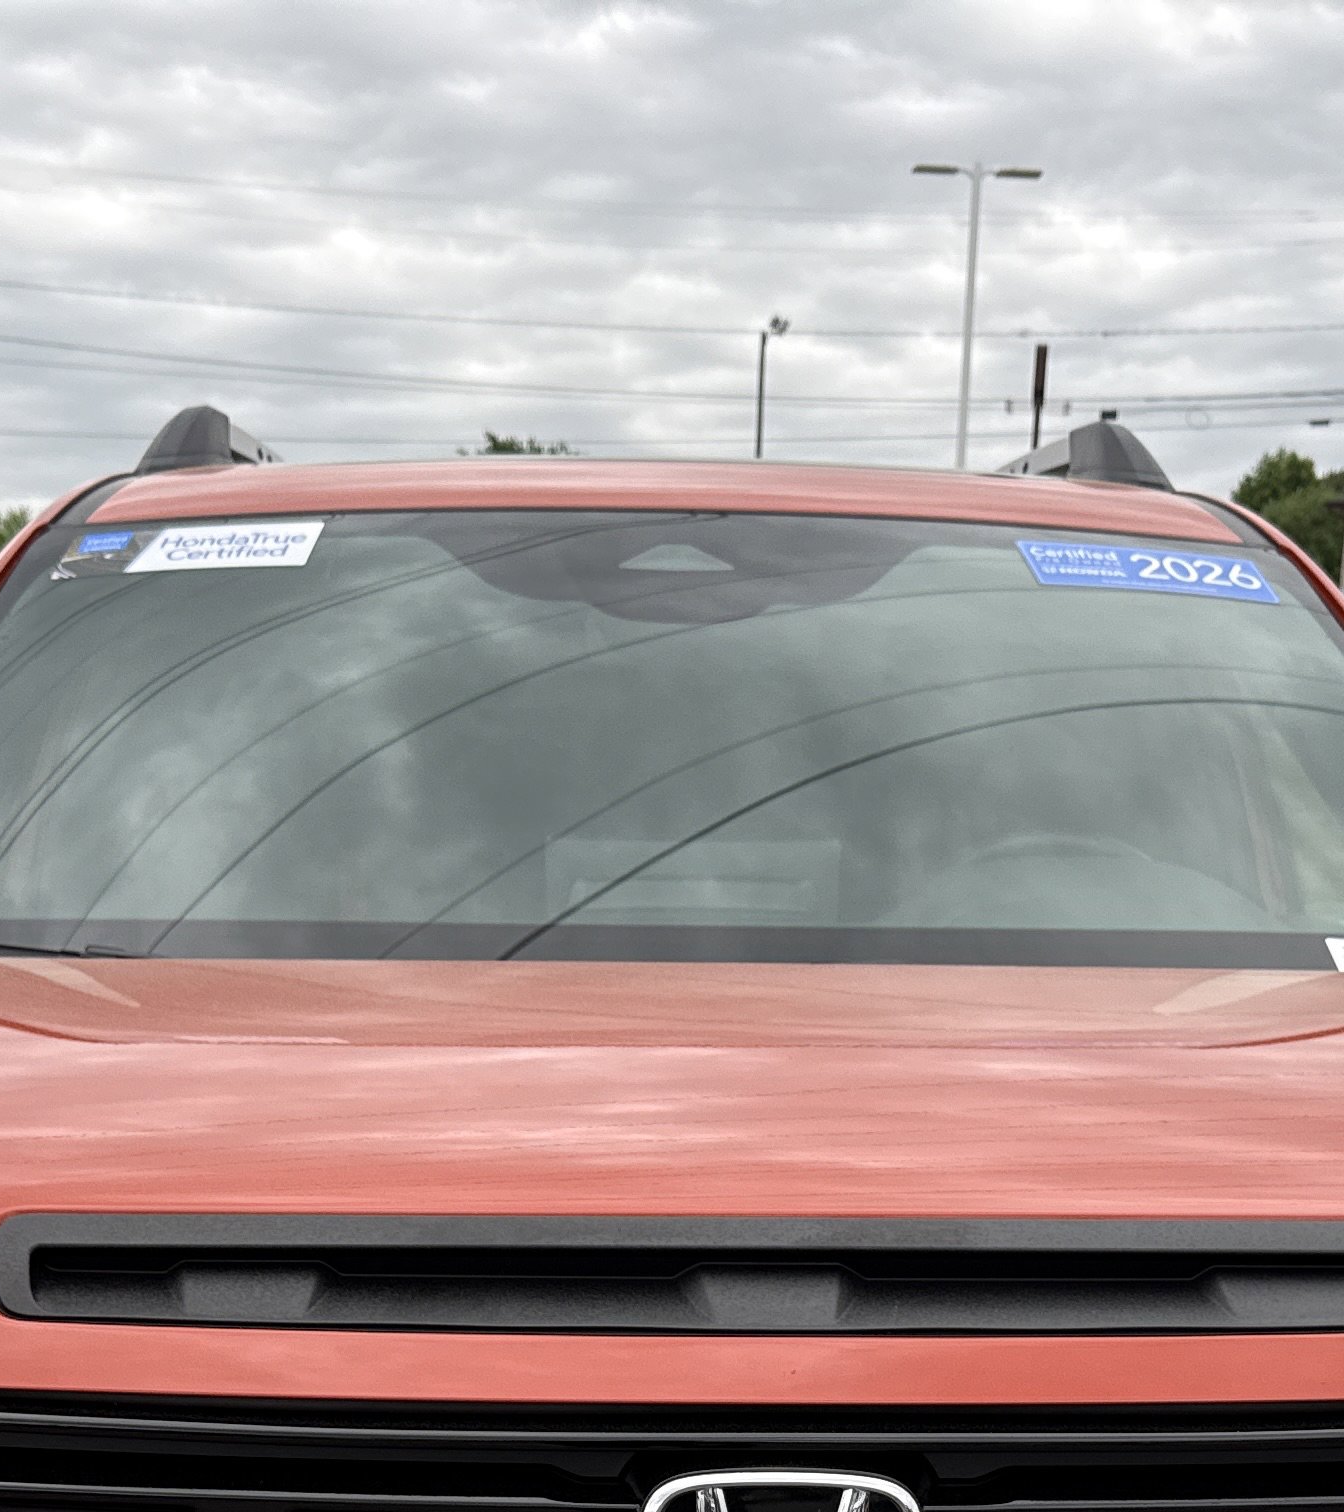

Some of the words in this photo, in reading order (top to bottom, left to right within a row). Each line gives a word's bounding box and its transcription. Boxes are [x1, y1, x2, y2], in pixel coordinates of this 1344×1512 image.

[160, 532, 308, 549] HondaTrue
[166, 545, 290, 561] Certified
[1029, 546, 1119, 561] Certified
[1129, 553, 1262, 590] 2026
